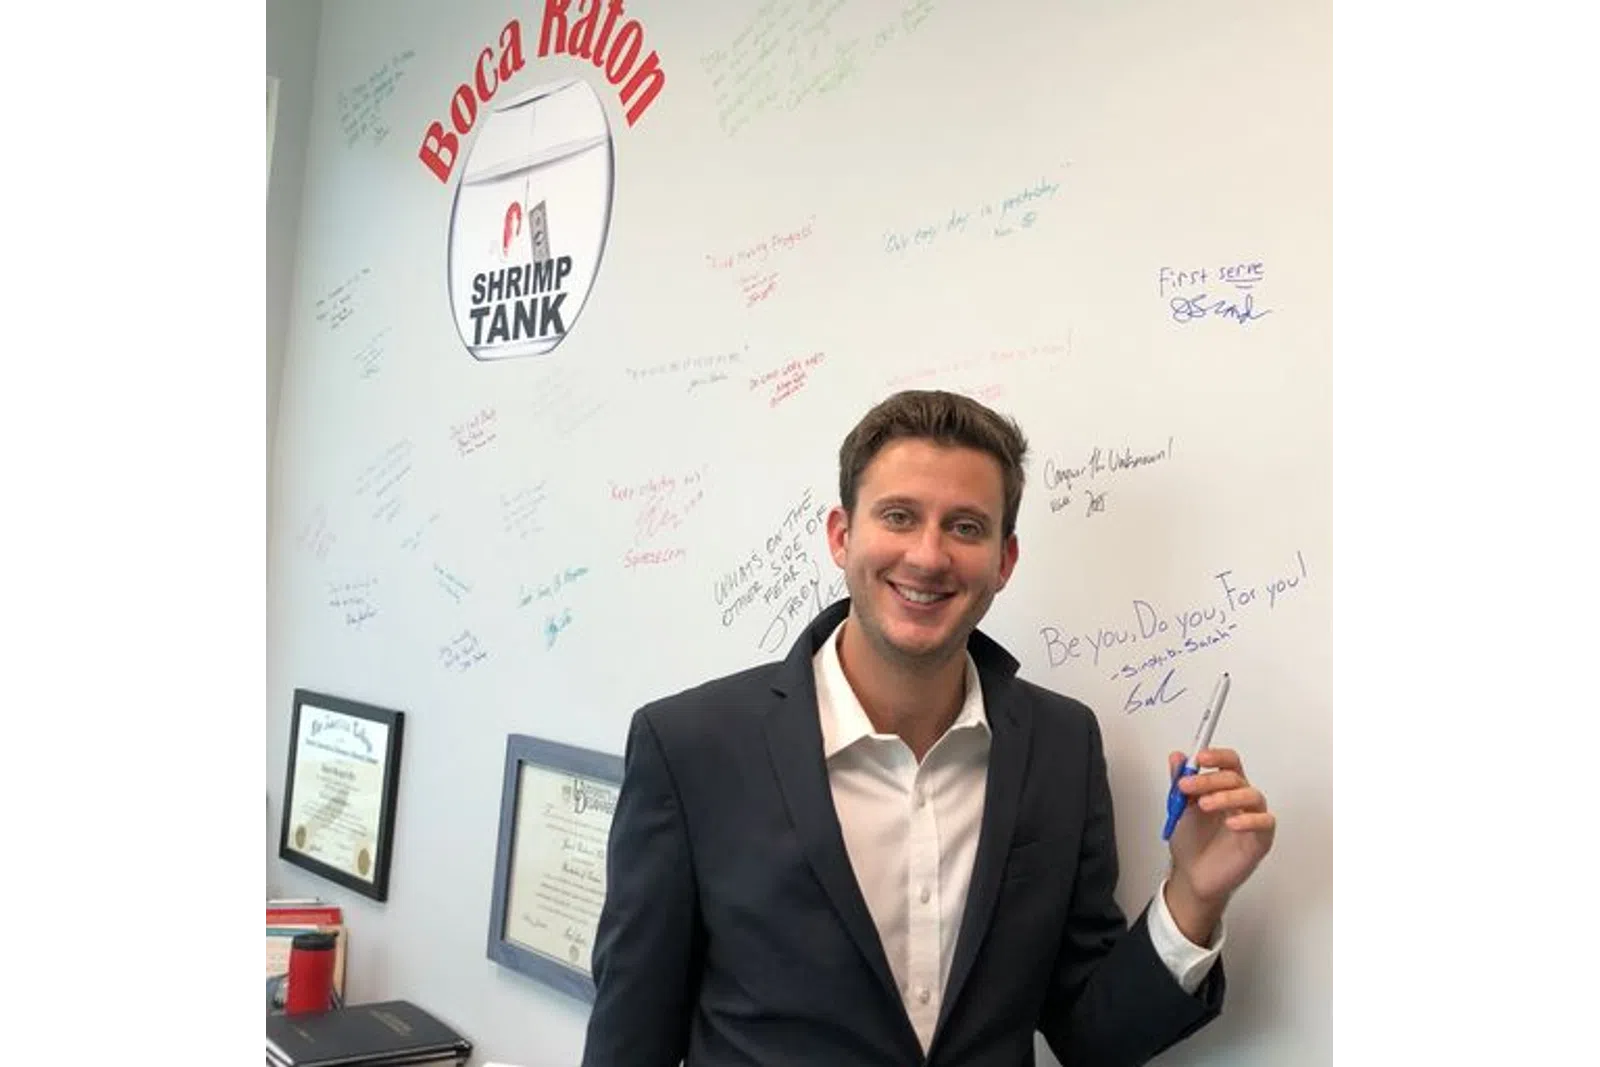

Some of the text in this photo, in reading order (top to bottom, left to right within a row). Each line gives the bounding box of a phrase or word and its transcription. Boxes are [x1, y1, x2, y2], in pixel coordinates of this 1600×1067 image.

[418, 17, 526, 185] Boca
[537, 0, 666, 128] Raton
[471, 255, 572, 305] SHRIMP
[1159, 261, 1265, 298] First serve
[469, 292, 567, 346] TANK
[783, 488, 812, 530] THE
[722, 580, 764, 627] OTHER
[770, 533, 803, 576] SIDE
[805, 504, 828, 535] OF
[1039, 550, 1307, 667] Be you, Do you, For you!
